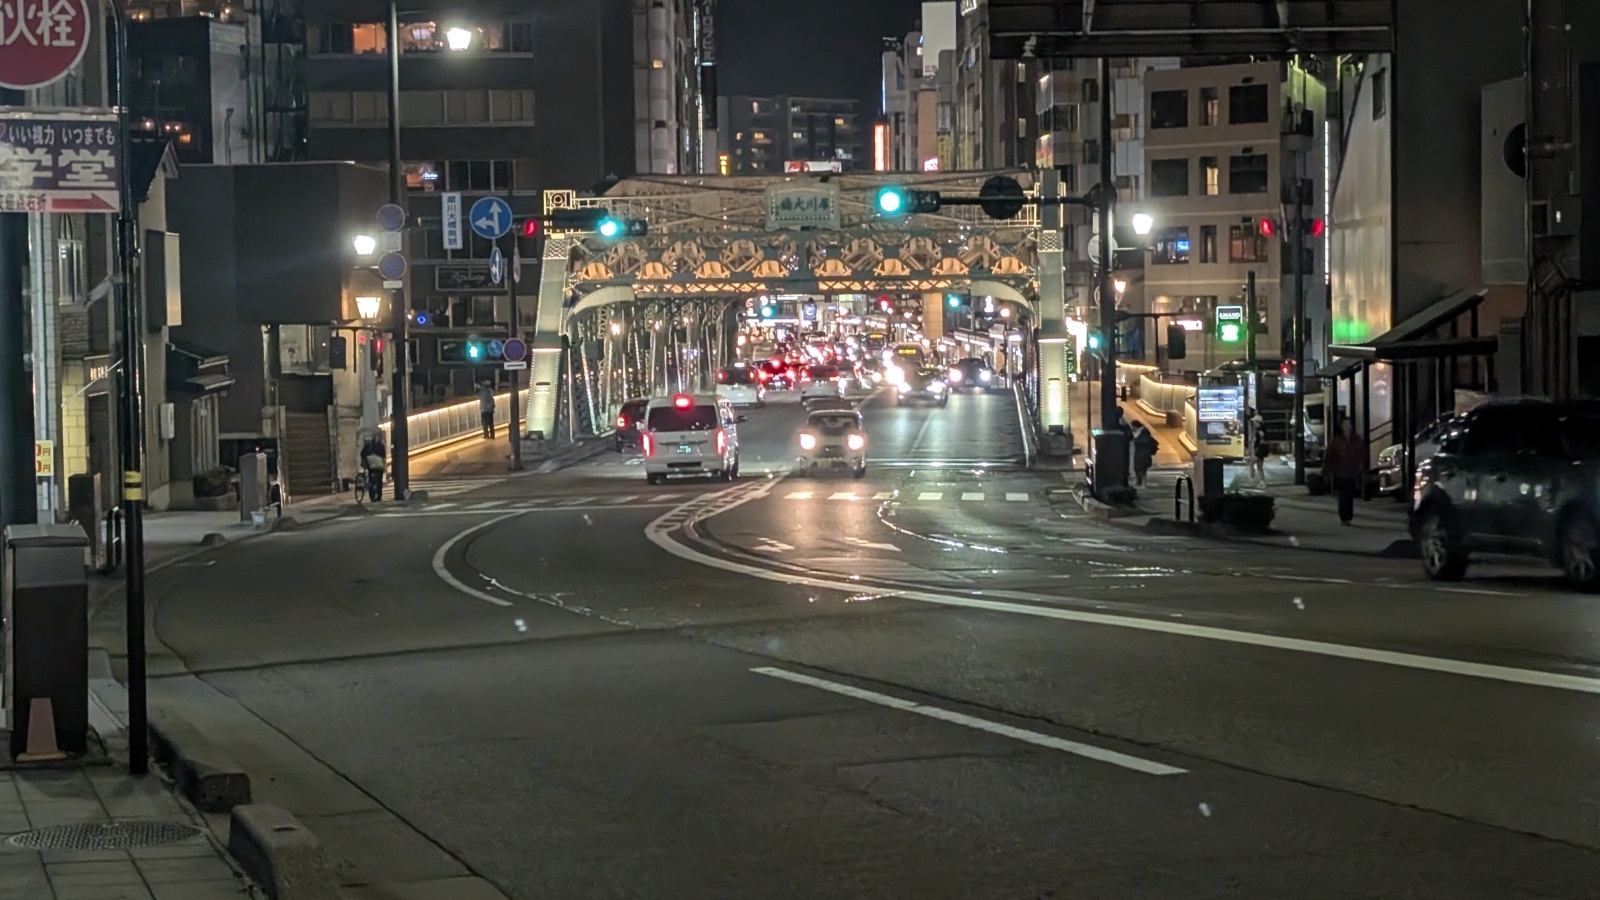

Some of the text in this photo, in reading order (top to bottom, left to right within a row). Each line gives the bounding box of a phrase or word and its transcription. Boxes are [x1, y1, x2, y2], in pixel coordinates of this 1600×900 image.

[0, 0, 76, 46] 火栓
[62, 126, 116, 145] いつまでも
